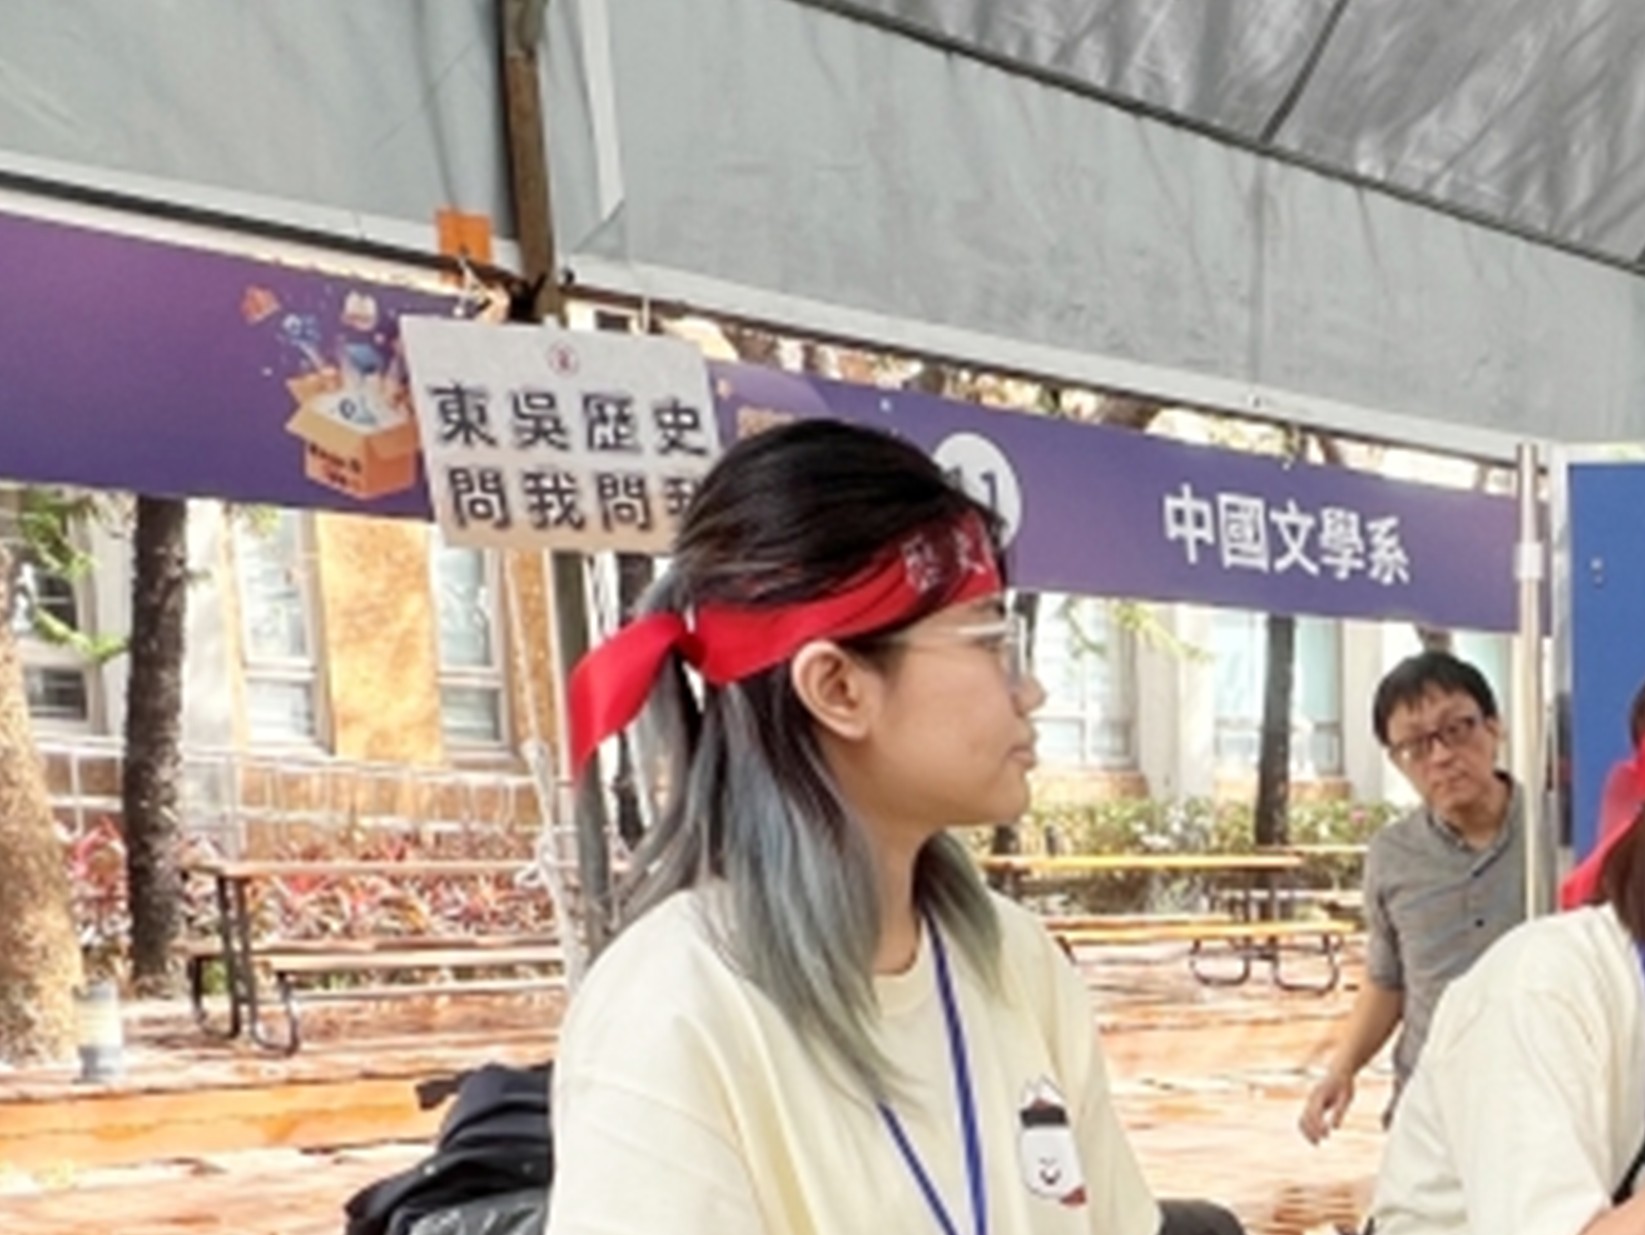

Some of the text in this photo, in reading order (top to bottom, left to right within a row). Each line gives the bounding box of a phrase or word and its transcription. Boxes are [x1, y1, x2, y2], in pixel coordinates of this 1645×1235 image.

[428, 381, 709, 457] 東吳歷史
[1163, 483, 1410, 586] 中國文學系
